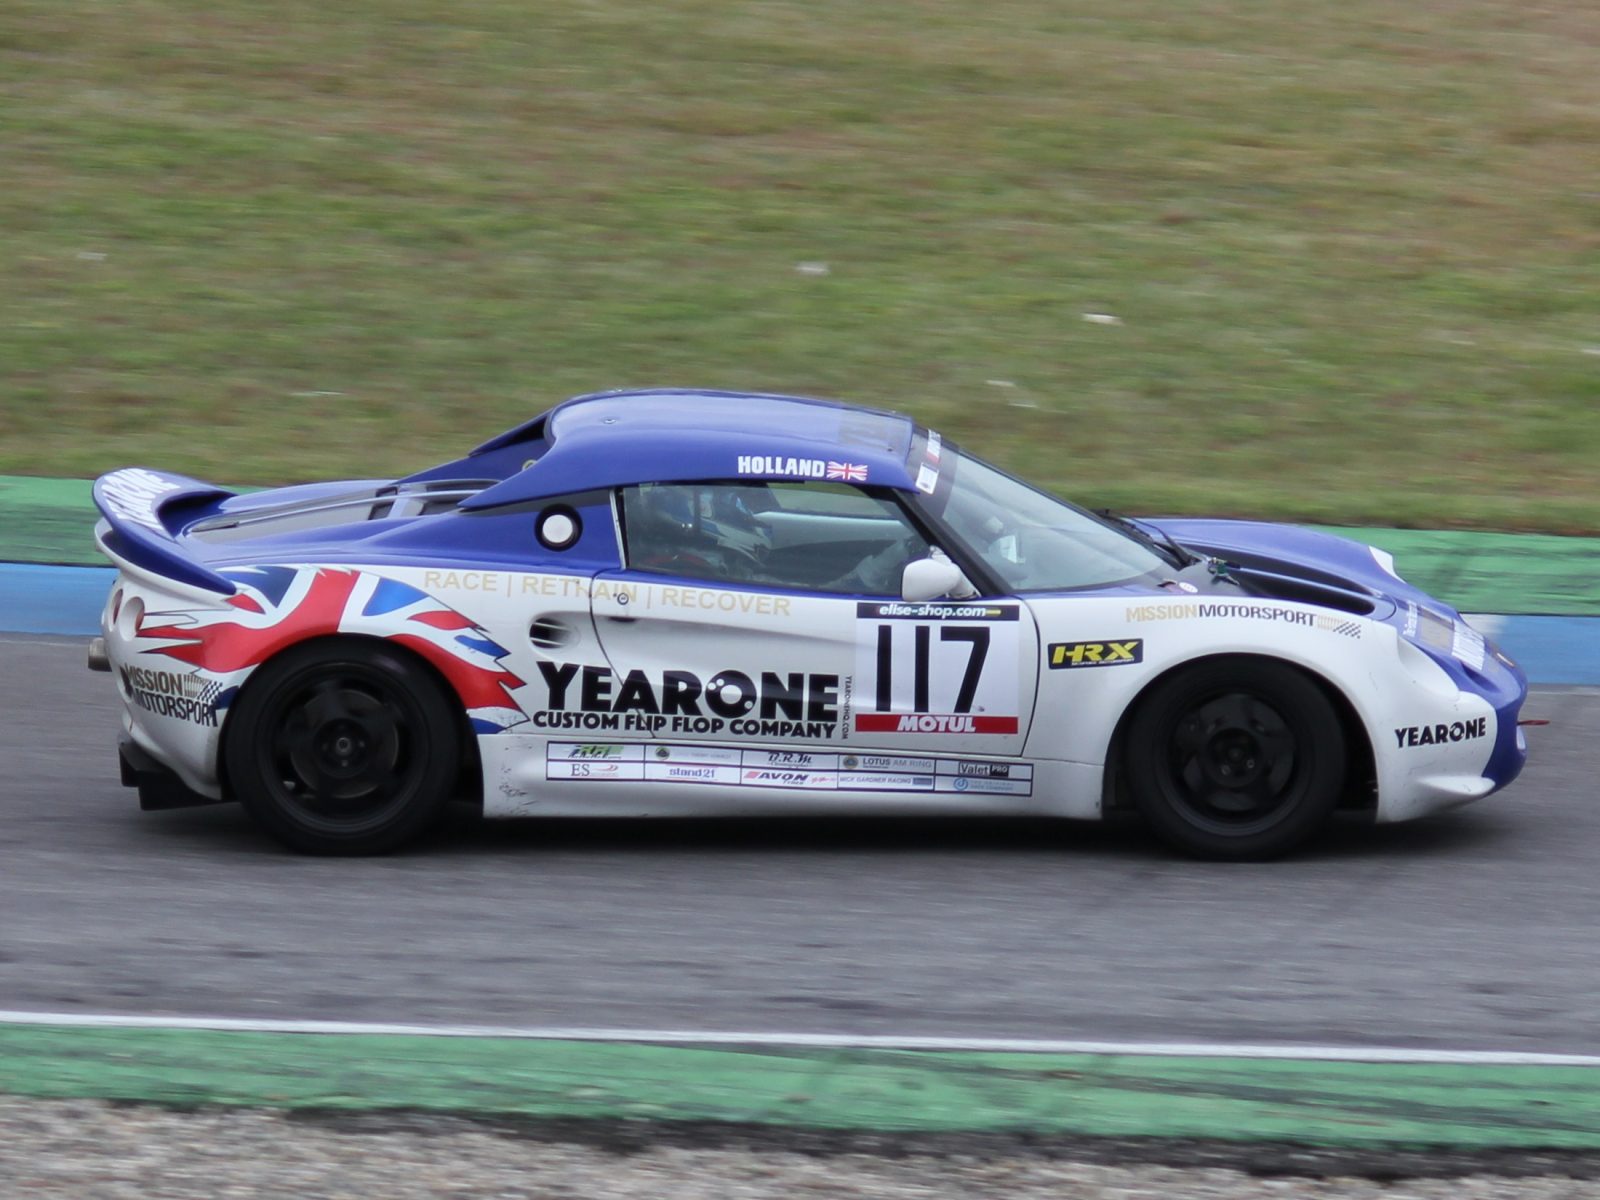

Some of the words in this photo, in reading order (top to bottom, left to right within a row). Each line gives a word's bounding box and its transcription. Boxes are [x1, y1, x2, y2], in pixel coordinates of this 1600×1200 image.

[737, 455, 825, 478] HOLLAND
[424, 570, 498, 592] RACE
[521, 576, 637, 603] RETRAIN
[661, 588, 791, 616] RECOVER
[879, 603, 987, 619] elise-shop.com
[1052, 641, 1139, 664] HRX
[124, 662, 183, 696] MISSION
[875, 624, 991, 714] 117
[536, 661, 839, 722] YEARONE
[132, 688, 219, 727] MOTORSPORT
[532, 710, 621, 730] CUSTOM
[625, 713, 667, 732] FLIP
[672, 715, 724, 734] FLOP
[729, 718, 837, 739] COMPANY
[897, 716, 976, 733] MOTUL
[1395, 717, 1486, 748] YEARONE
[862, 757, 891, 766] LOTUS
[892, 759, 907, 767] AM
[909, 760, 932, 768] RING
[961, 764, 989, 774] Valet
[991, 765, 1008, 773] PRO
[758, 772, 810, 781] AVON
